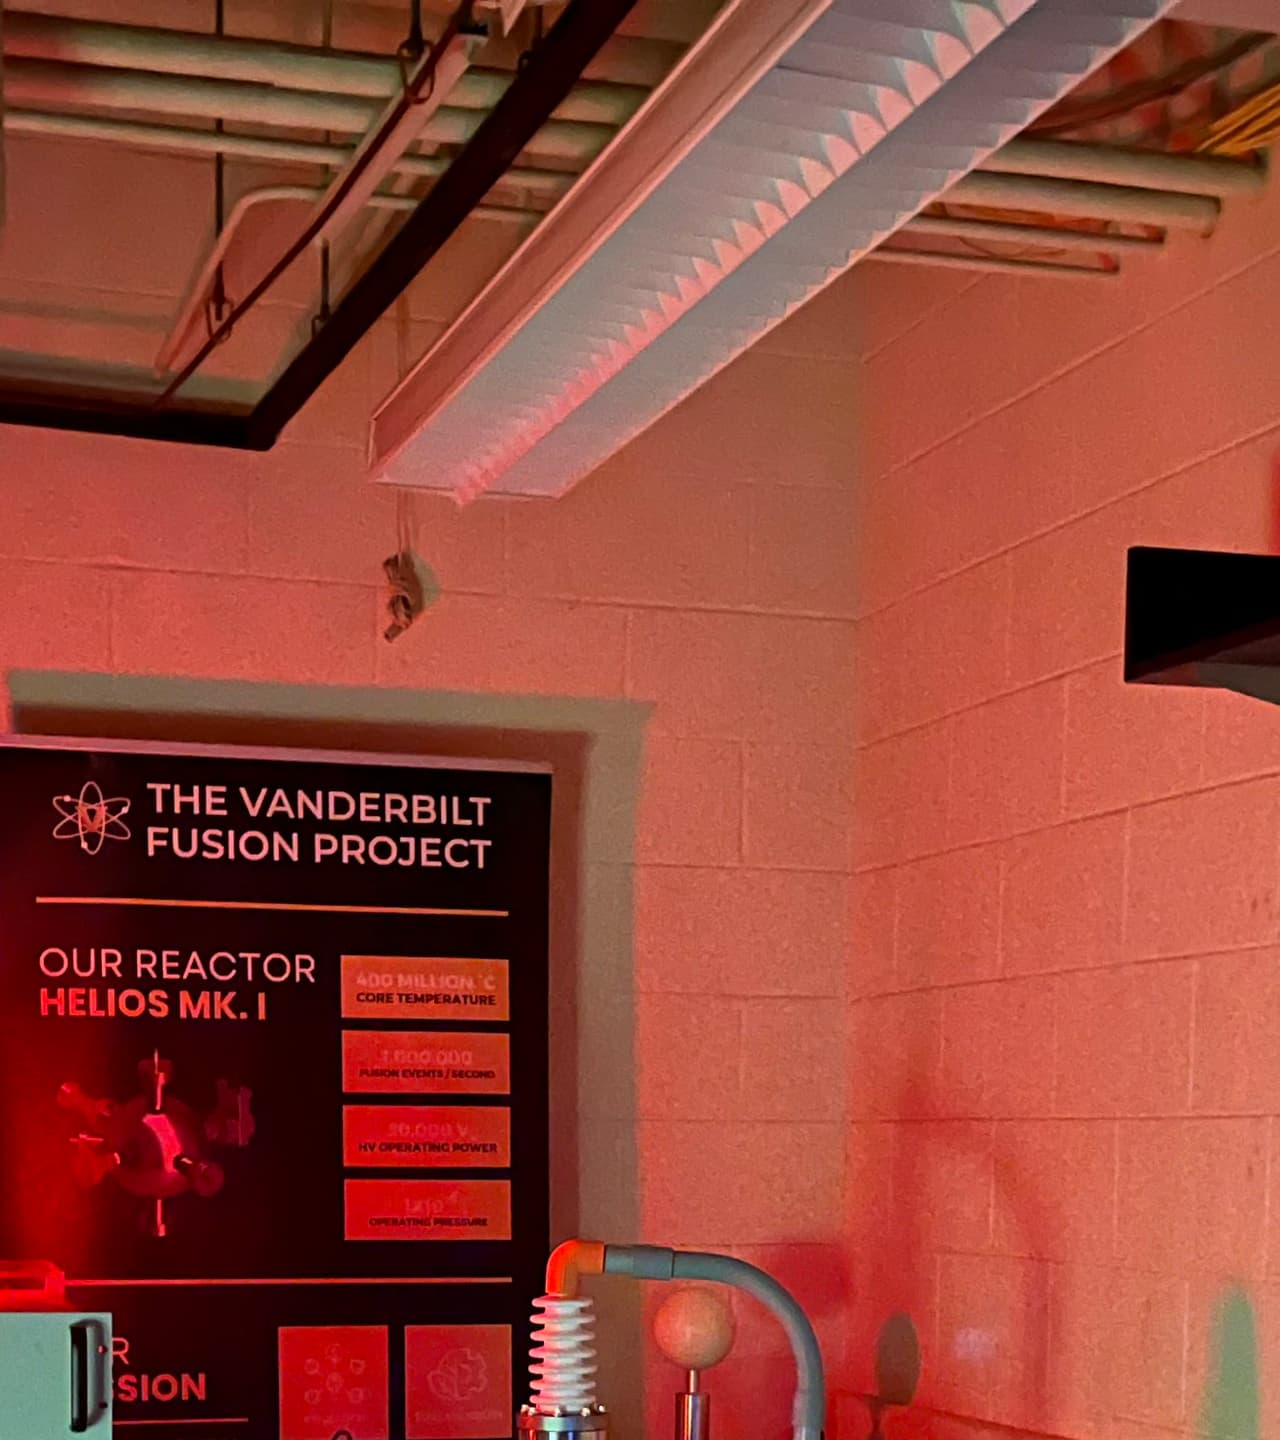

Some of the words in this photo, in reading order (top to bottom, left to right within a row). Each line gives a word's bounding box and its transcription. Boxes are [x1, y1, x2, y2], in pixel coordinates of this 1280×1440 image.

[146, 783, 227, 817] THE
[239, 787, 492, 826] VANDERBILT
[146, 827, 299, 862] FUSION
[314, 833, 493, 869] PROJECT
[38, 947, 122, 979] OUR
[136, 949, 317, 984] REACTOR
[39, 987, 169, 1019] HELIOS
[179, 991, 249, 1020] MK.
[257, 992, 267, 1021] I
[356, 992, 394, 1005] CORE
[397, 992, 497, 1006] TEMPERATURE
[451, 1069, 496, 1080] SECOND
[378, 1142, 450, 1153] OPERATING
[451, 1143, 498, 1154] POWER
[112, 1372, 206, 1402] SION
